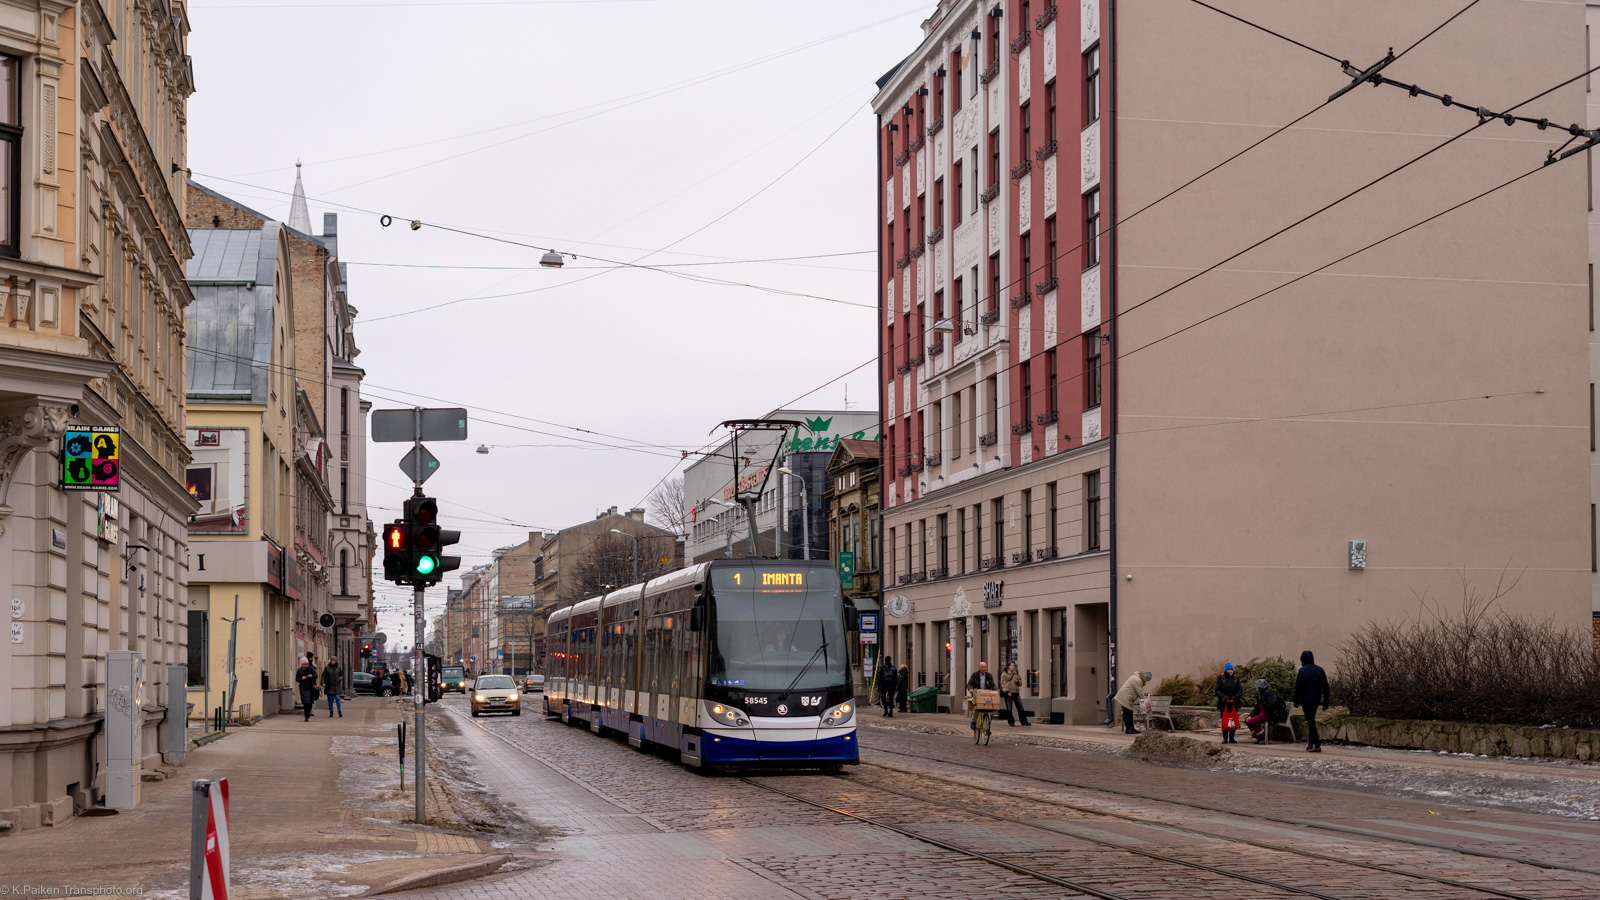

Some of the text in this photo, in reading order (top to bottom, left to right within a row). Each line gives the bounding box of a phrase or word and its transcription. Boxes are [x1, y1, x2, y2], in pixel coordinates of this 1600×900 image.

[733, 573, 803, 585] 1 IMANTA
[744, 697, 768, 705] 58545
